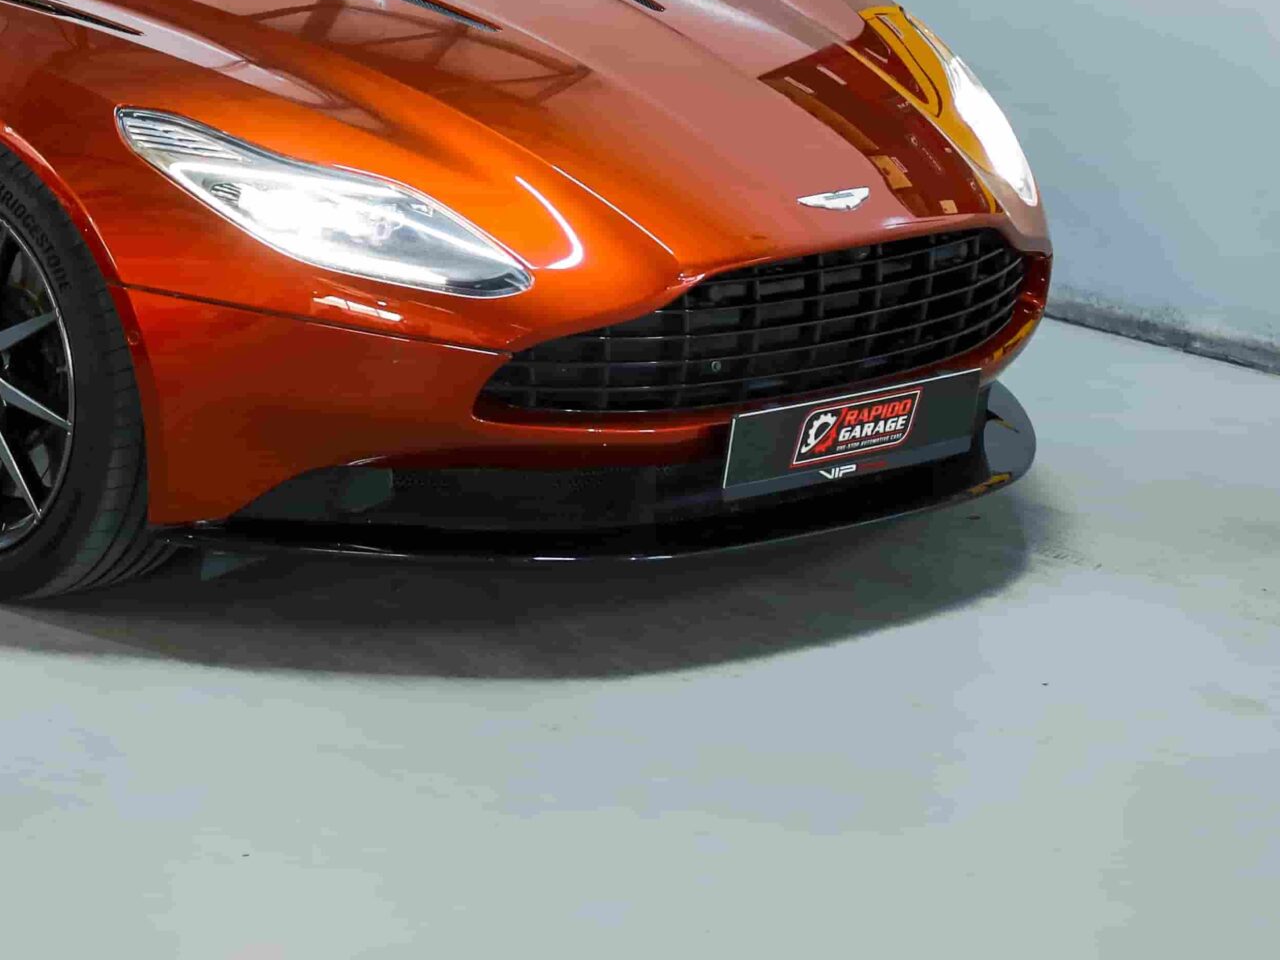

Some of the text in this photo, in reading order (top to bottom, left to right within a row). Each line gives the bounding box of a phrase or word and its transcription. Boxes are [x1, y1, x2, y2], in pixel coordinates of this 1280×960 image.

[844, 399, 912, 426] RAPIDO
[838, 415, 908, 442] GARAGE
[819, 464, 857, 479] VIP
